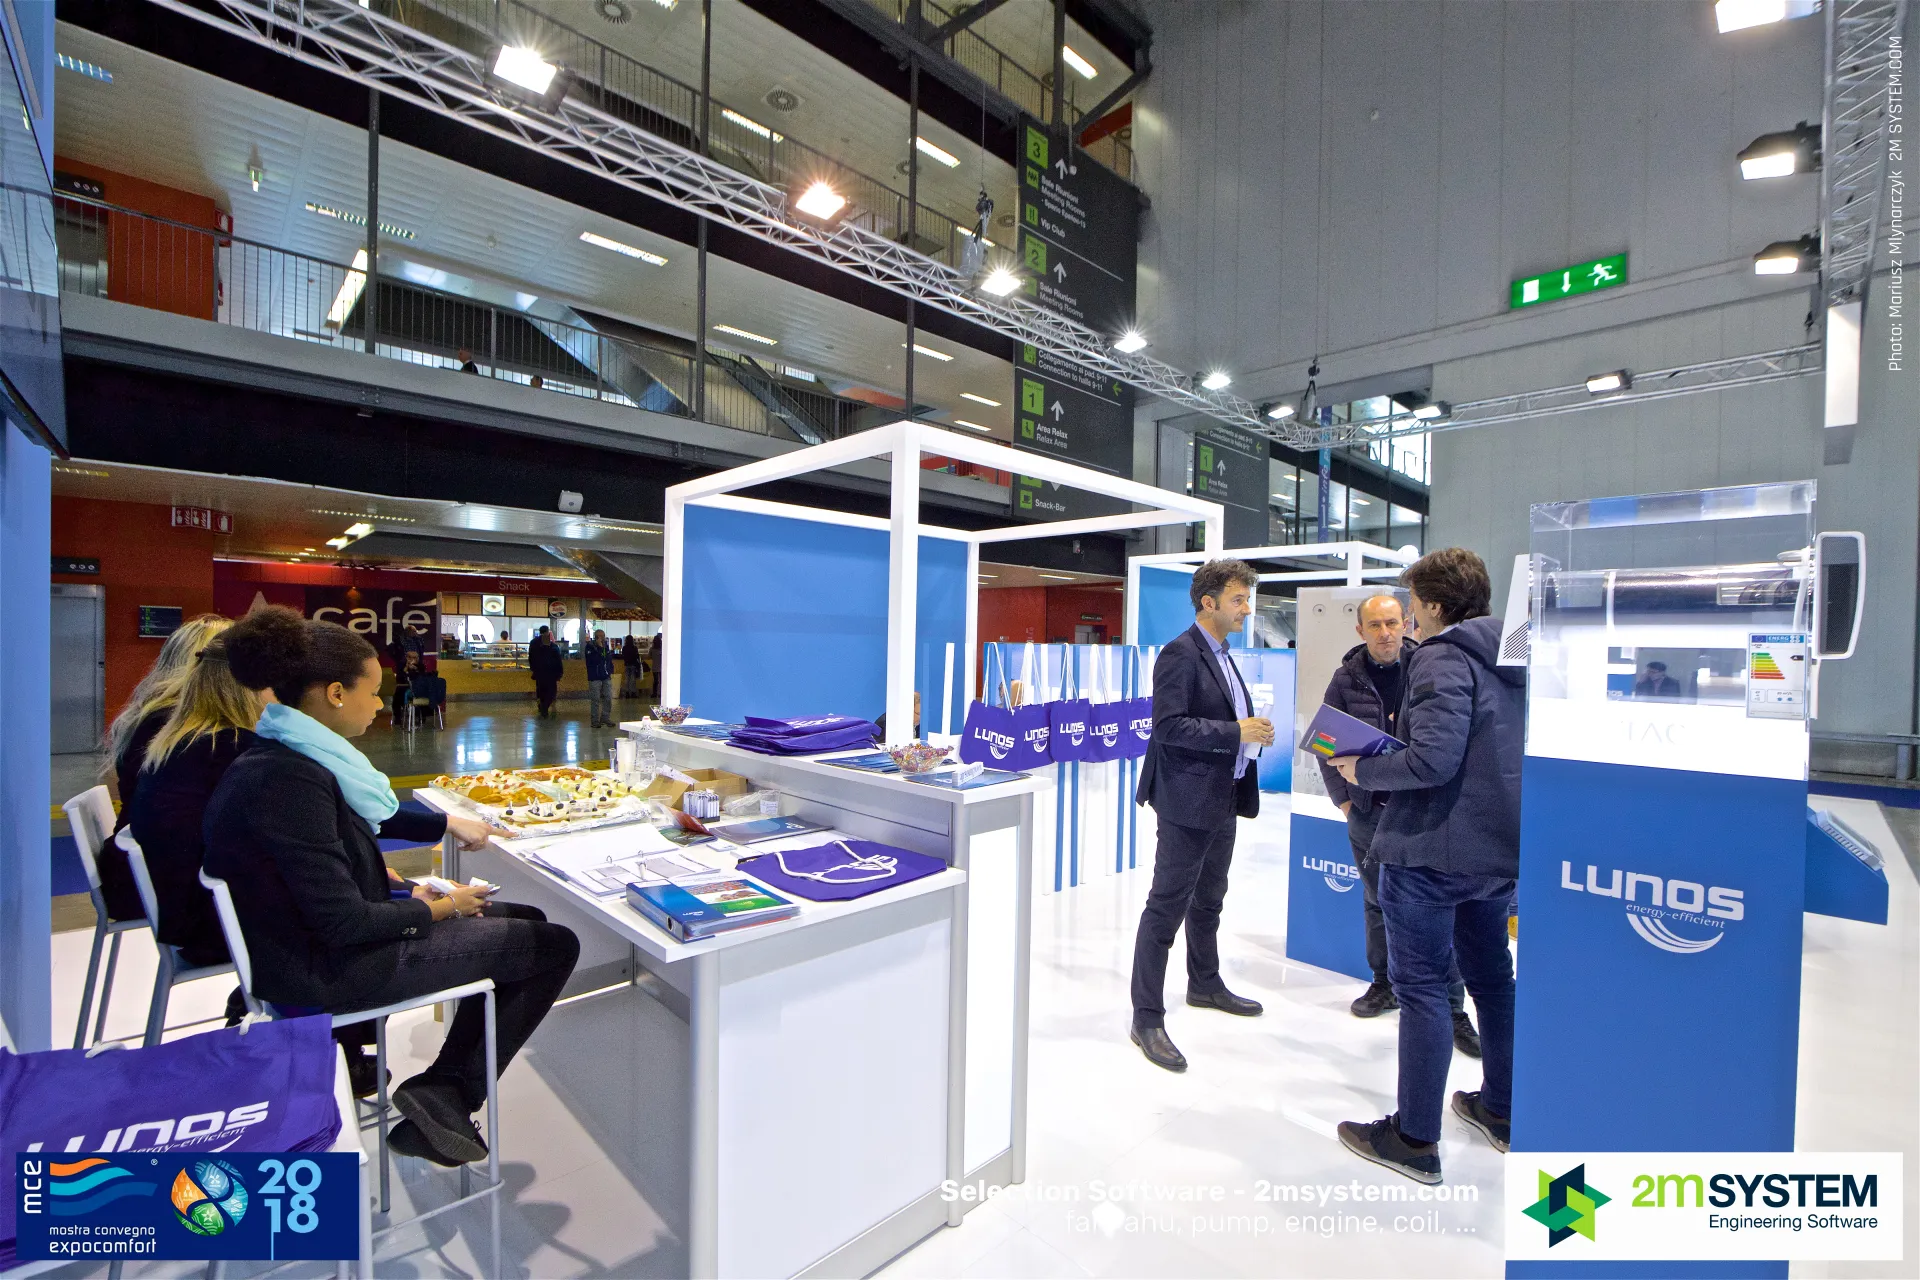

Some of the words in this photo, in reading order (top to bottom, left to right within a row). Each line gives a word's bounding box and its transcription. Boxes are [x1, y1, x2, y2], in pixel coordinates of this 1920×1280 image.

[1033, 142, 1041, 158] 3
[1041, 186, 1065, 207] Meeting
[1066, 200, 1085, 218] Rooms
[1040, 218, 1051, 231] Vip
[1051, 224, 1066, 238] Club
[1031, 249, 1039, 266] 2
[1040, 281, 1053, 294] Sale
[1053, 288, 1077, 306] Riunioni
[1039, 291, 1063, 310] Meeting
[1064, 303, 1084, 319] Rooms
[1038, 350, 1077, 372] Collegamento
[1096, 372, 1107, 384] 9-11
[1038, 360, 1071, 379] Connection
[1071, 372, 1078, 381] to
[1078, 374, 1091, 386] halls
[1092, 381, 1103, 392] 9-11
[1028, 392, 1035, 408] 1
[1036, 423, 1051, 434] Area
[1051, 427, 1068, 439] Relax
[1036, 433, 1053, 445] Relax
[1053, 439, 1068, 449] Area
[1035, 498, 1066, 512] Snack-Bar
[499, 580, 530, 592] Snack
[974, 727, 1015, 748] LUNOS
[1024, 727, 1050, 742] UNOS
[1303, 855, 1360, 880] LUNOS
[1561, 860, 1745, 921] LUNOS
[1626, 903, 1726, 929] energy-efficient
[27, 1100, 269, 1152] UNOS
